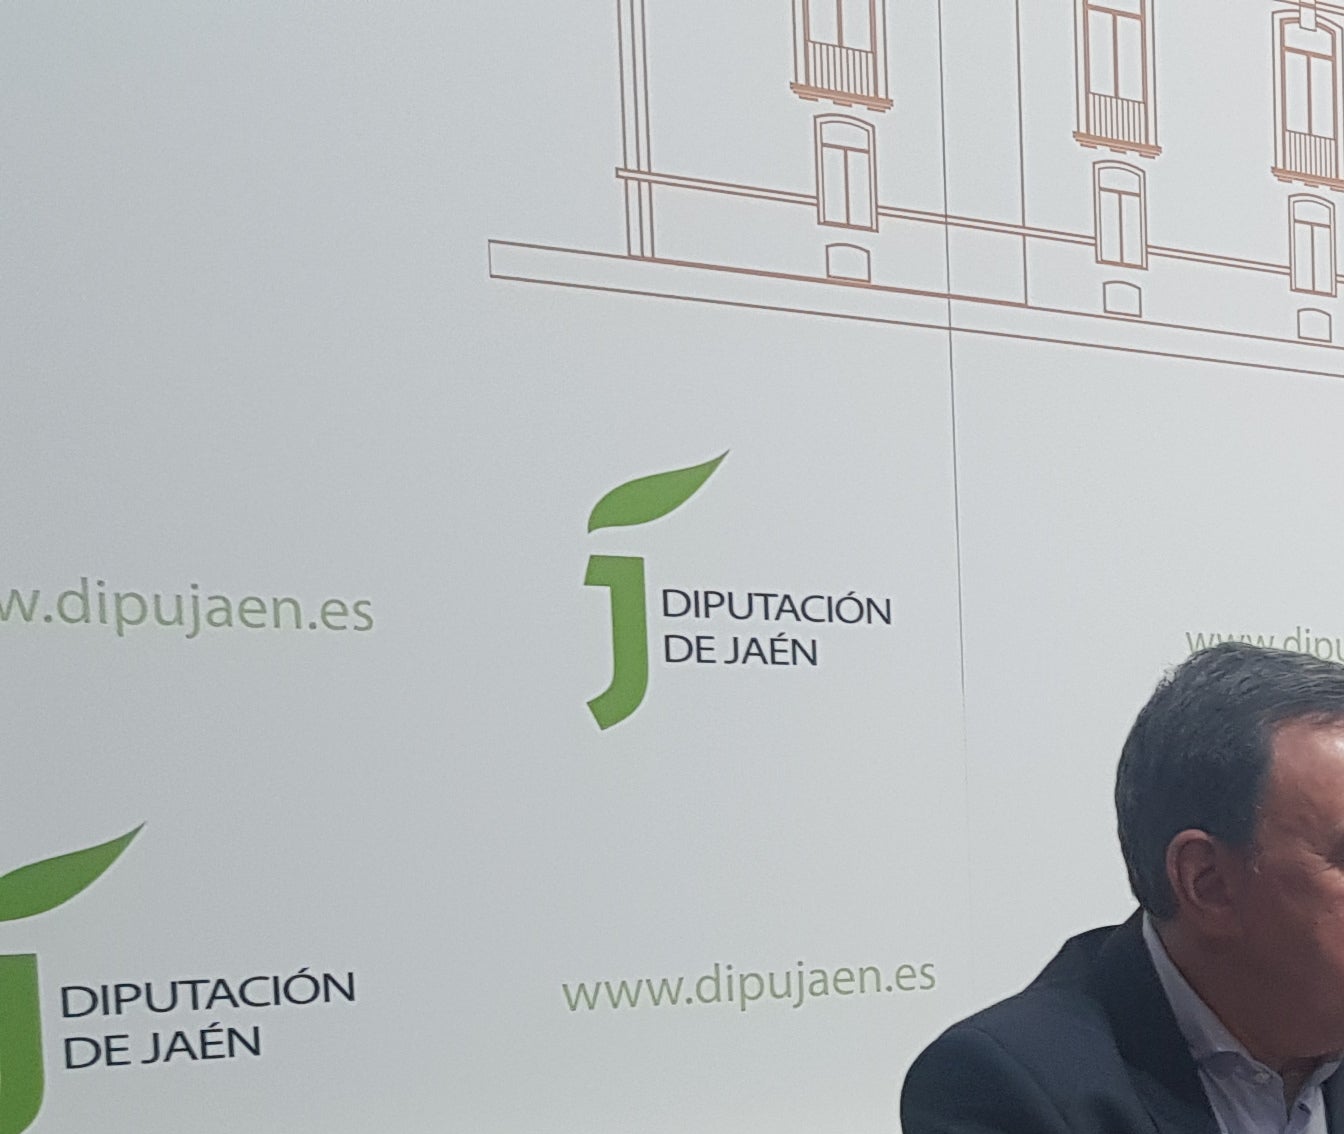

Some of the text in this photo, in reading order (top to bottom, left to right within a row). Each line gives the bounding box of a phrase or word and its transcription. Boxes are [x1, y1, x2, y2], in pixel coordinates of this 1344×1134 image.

[0, 577, 374, 639] w.dipujaen.es
[663, 589, 891, 624] DIPUTACIÓN
[665, 632, 817, 665] DE JAÉN
[61, 968, 354, 1017] DIPUTACIÓN
[562, 960, 935, 1012] www.dipujaen.es
[65, 1022, 260, 1069] DE JAÉN
